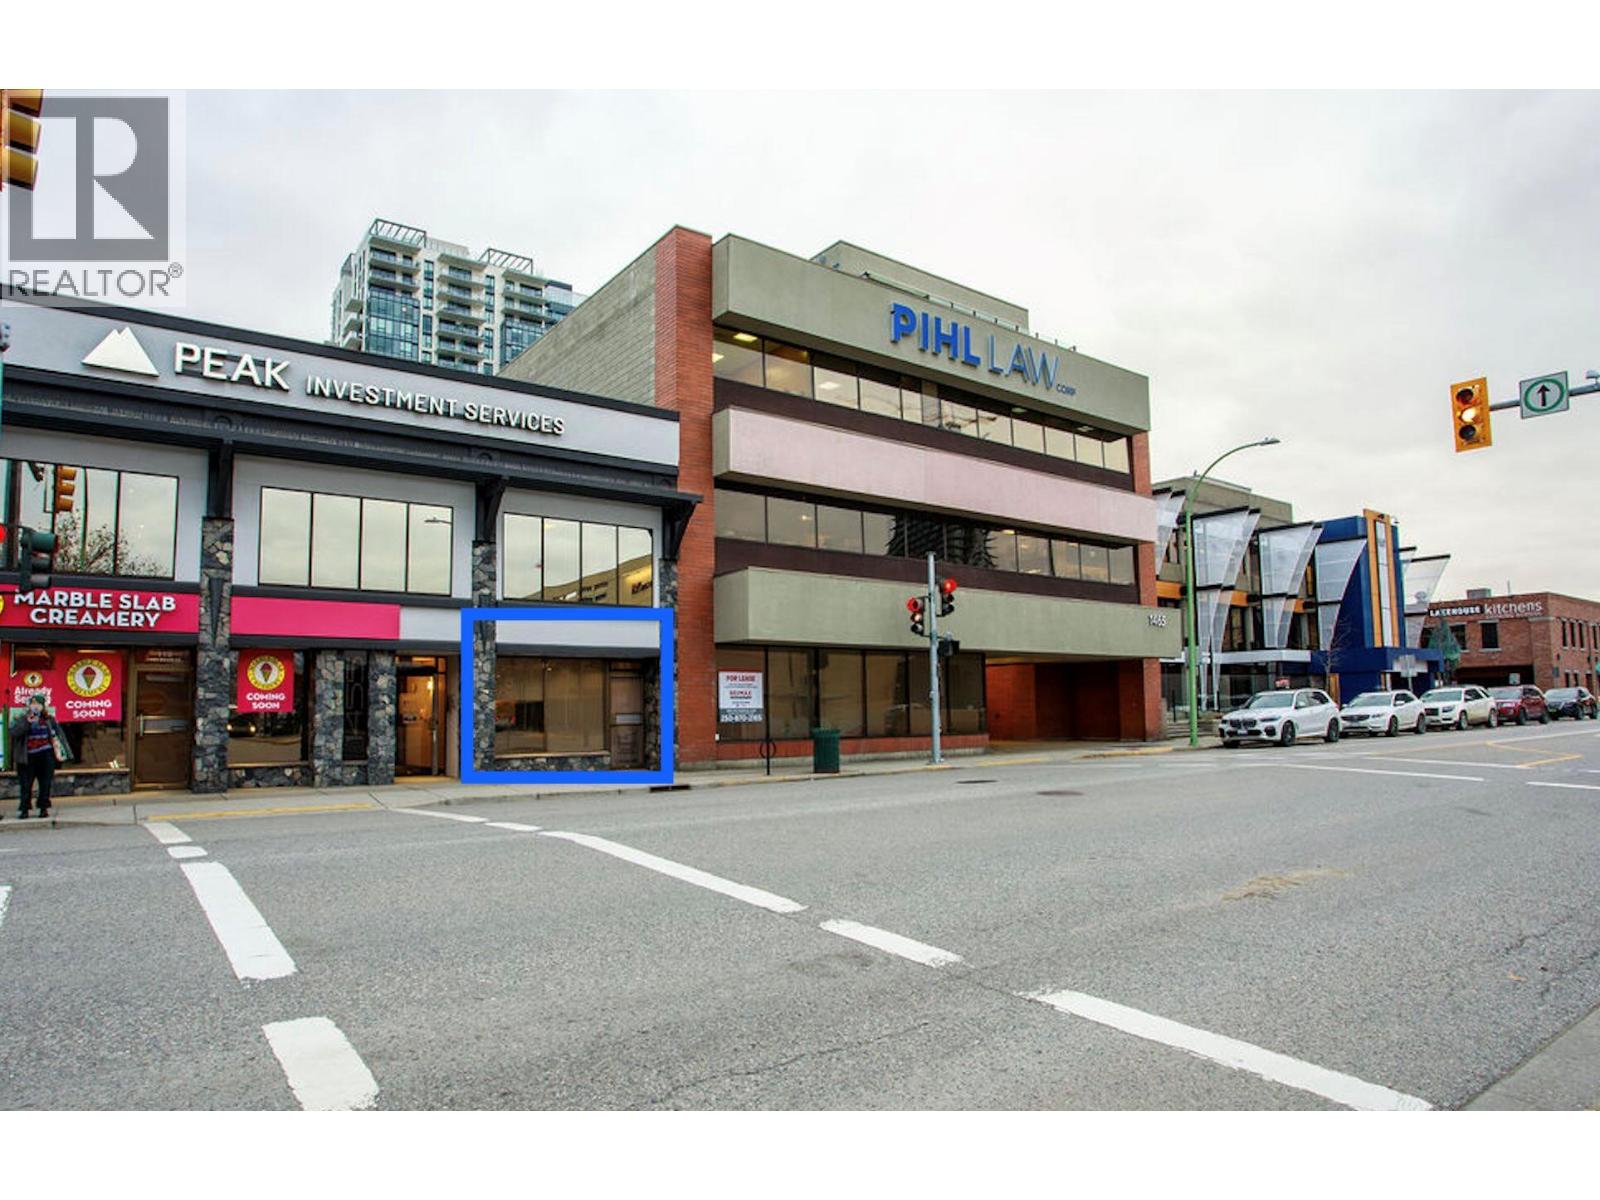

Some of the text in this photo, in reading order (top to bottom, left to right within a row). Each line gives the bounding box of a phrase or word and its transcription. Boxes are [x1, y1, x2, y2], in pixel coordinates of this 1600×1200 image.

[890, 303, 981, 368] PIHL
[987, 334, 1059, 390] LAW
[173, 341, 566, 436] PEAK INVESTMENT SERVICES
[13, 588, 177, 611] MARBLE SLAB
[1484, 601, 1543, 615] kitchens
[29, 607, 160, 628] CREAMERY
[726, 674, 756, 682] FOR LEASE
[246, 692, 286, 701] COMING
[65, 699, 113, 710] COMING
[251, 702, 280, 710] SOON
[72, 708, 106, 719] SOON
